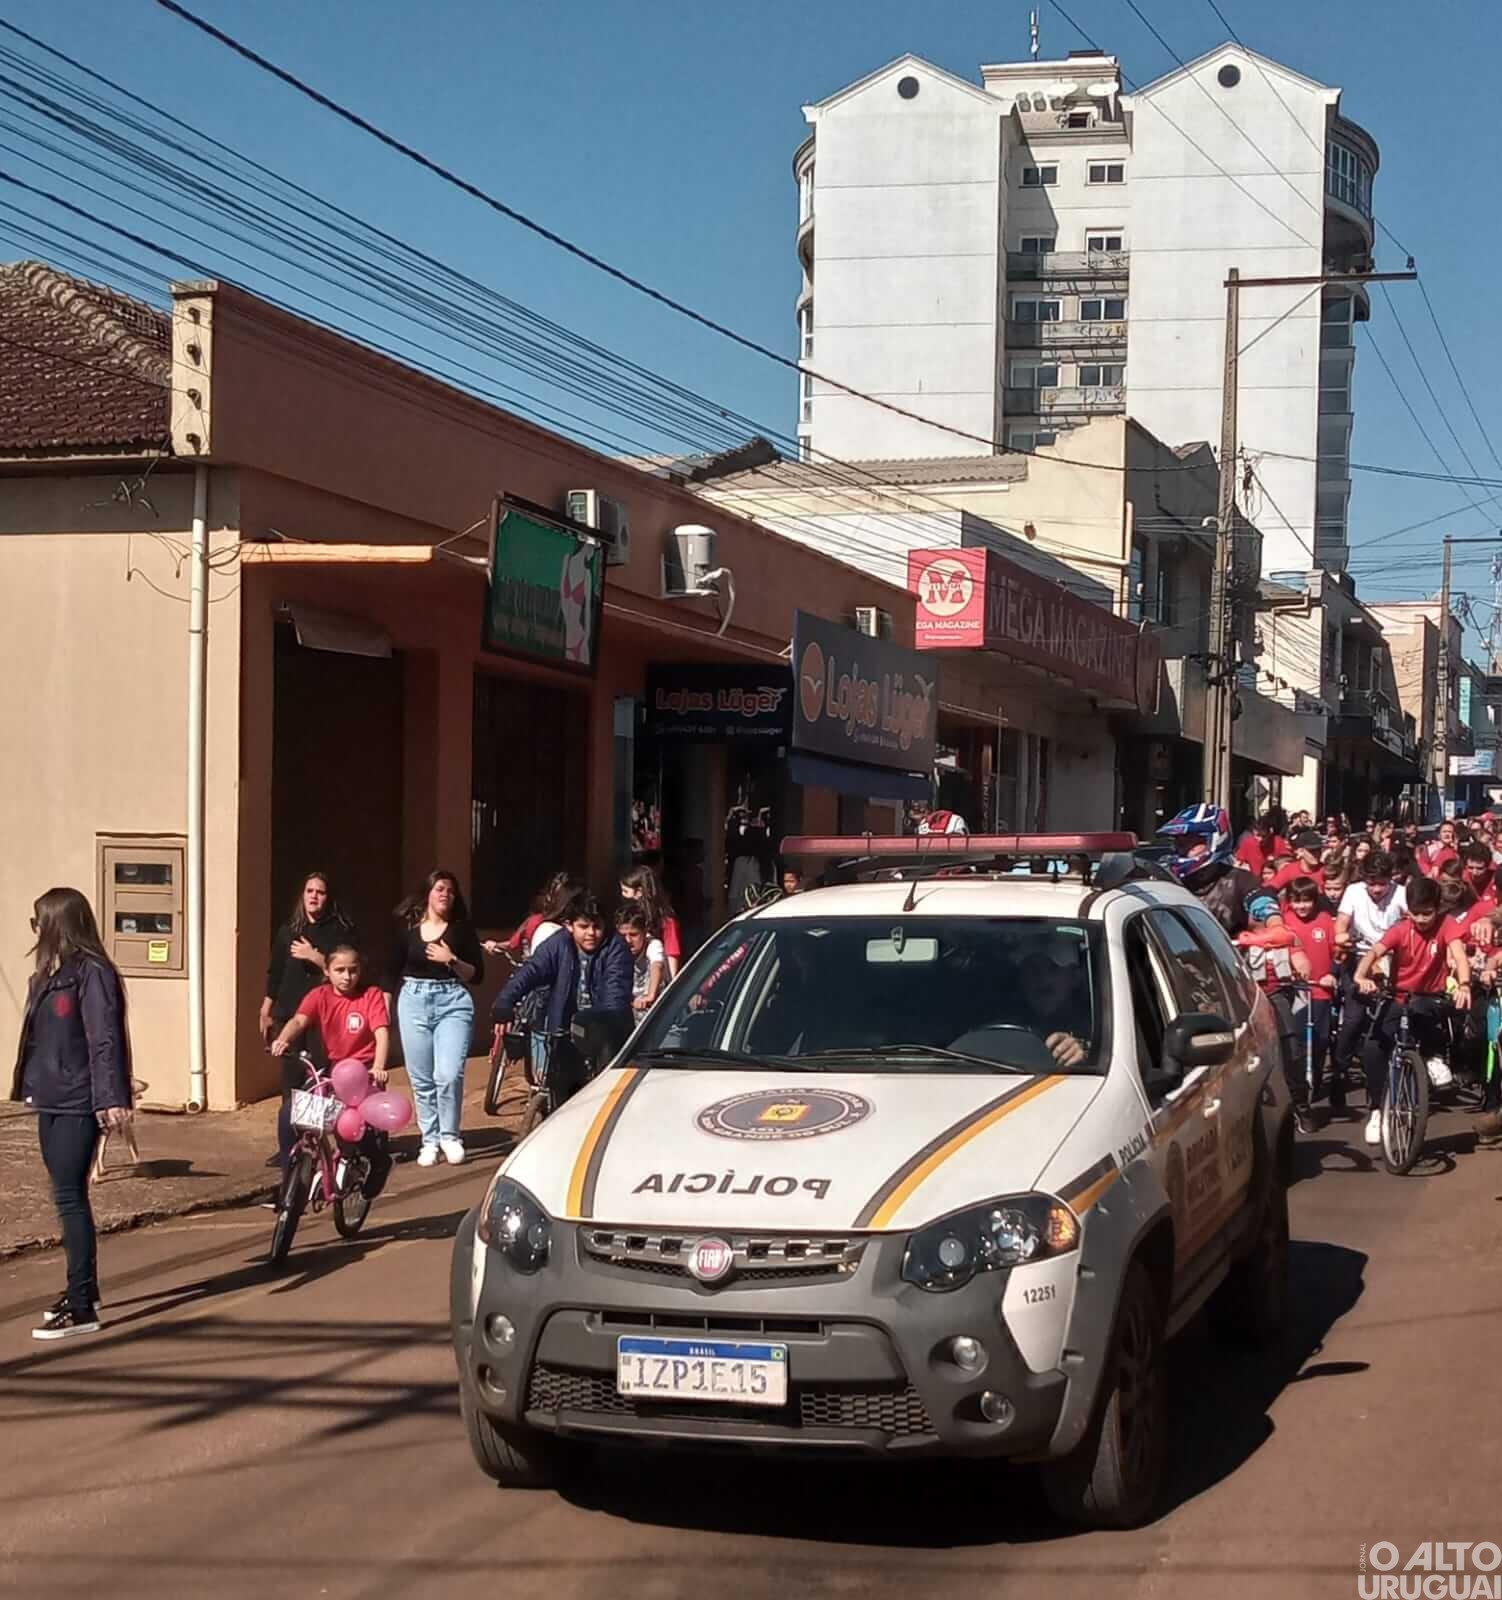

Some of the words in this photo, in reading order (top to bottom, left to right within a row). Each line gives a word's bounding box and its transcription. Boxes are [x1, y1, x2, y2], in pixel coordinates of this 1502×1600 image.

[916, 620, 934, 630] EGA
[935, 620, 981, 630] MAGAZINE
[990, 570, 1045, 649] MEGA
[1049, 598, 1130, 680] MAGAZINE
[656, 687, 713, 715] Lojas
[827, 655, 879, 737] Lojas
[700, 1249, 722, 1269] FIAT
[1023, 1283, 1056, 1304] 12251
[689, 1347, 716, 1356] BRASIL
[633, 1356, 768, 1394] IZP1E15
